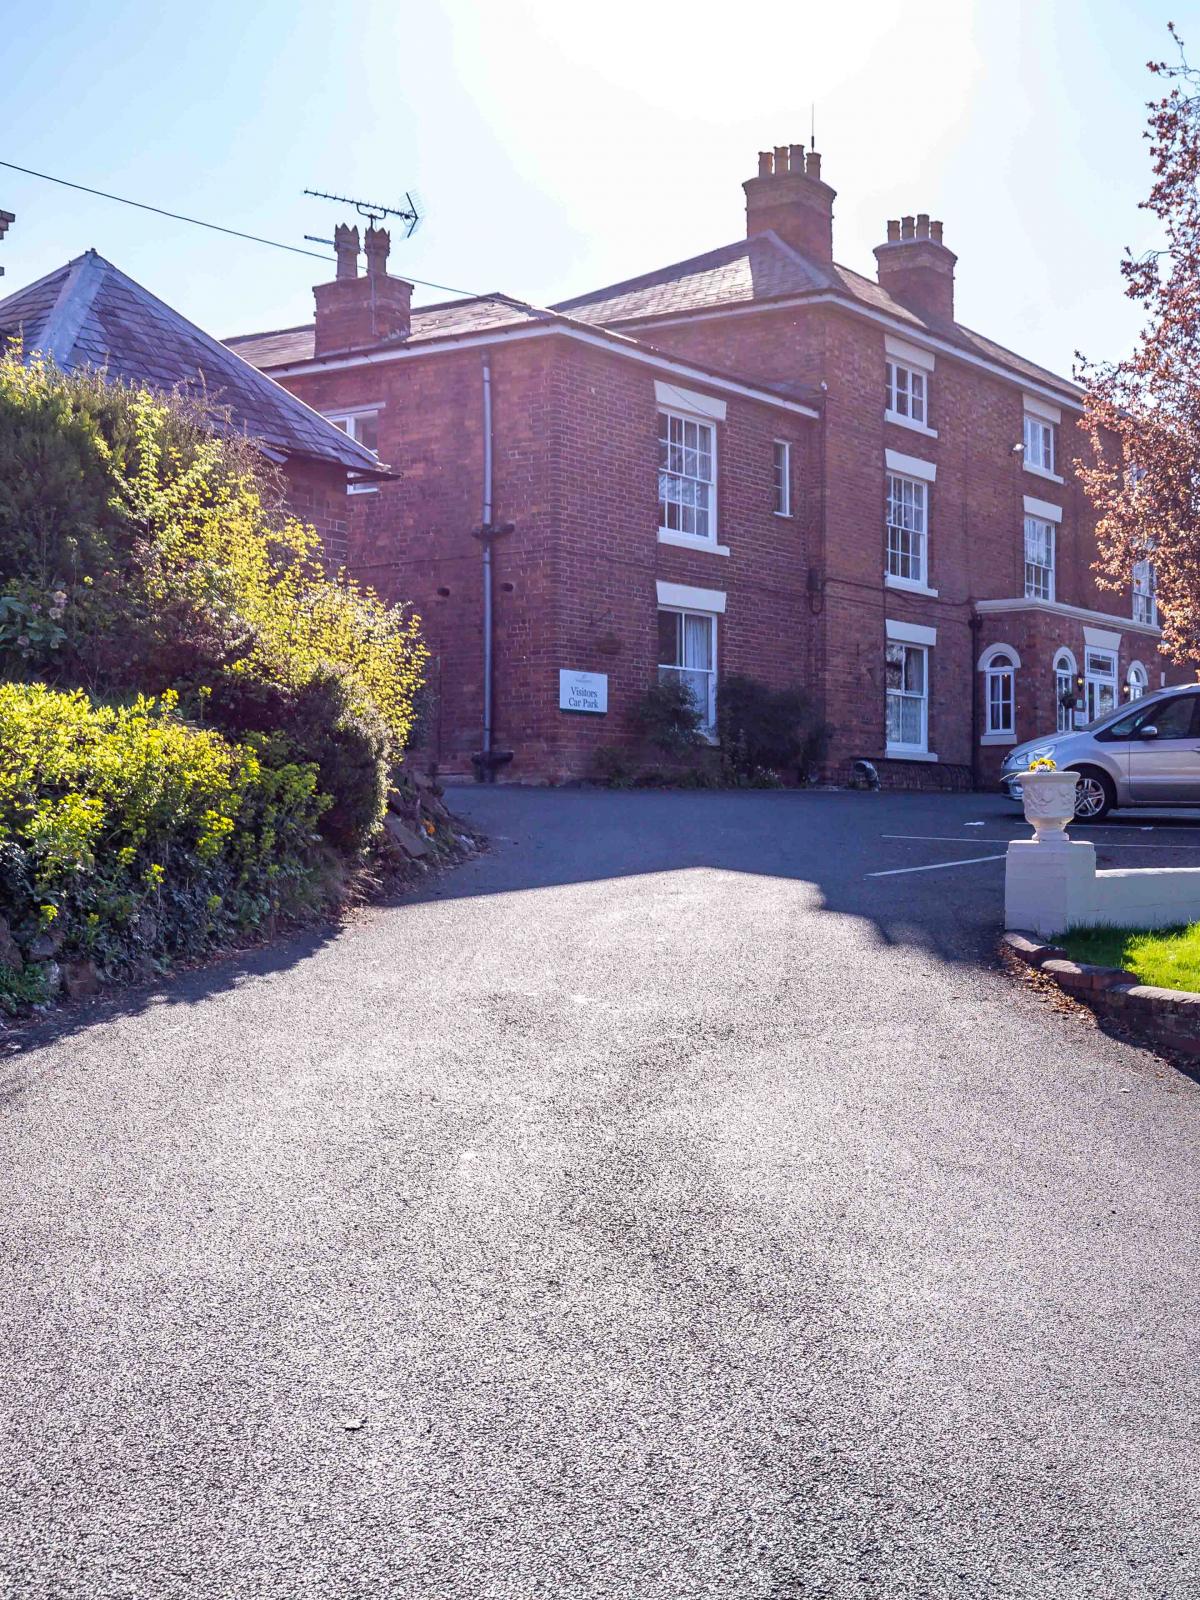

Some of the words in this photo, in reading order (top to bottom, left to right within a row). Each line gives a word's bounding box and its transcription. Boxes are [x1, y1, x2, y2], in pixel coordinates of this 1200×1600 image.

[571, 686, 598, 698] Visitors
[568, 697, 581, 707] Car
[583, 699, 599, 708] Park
